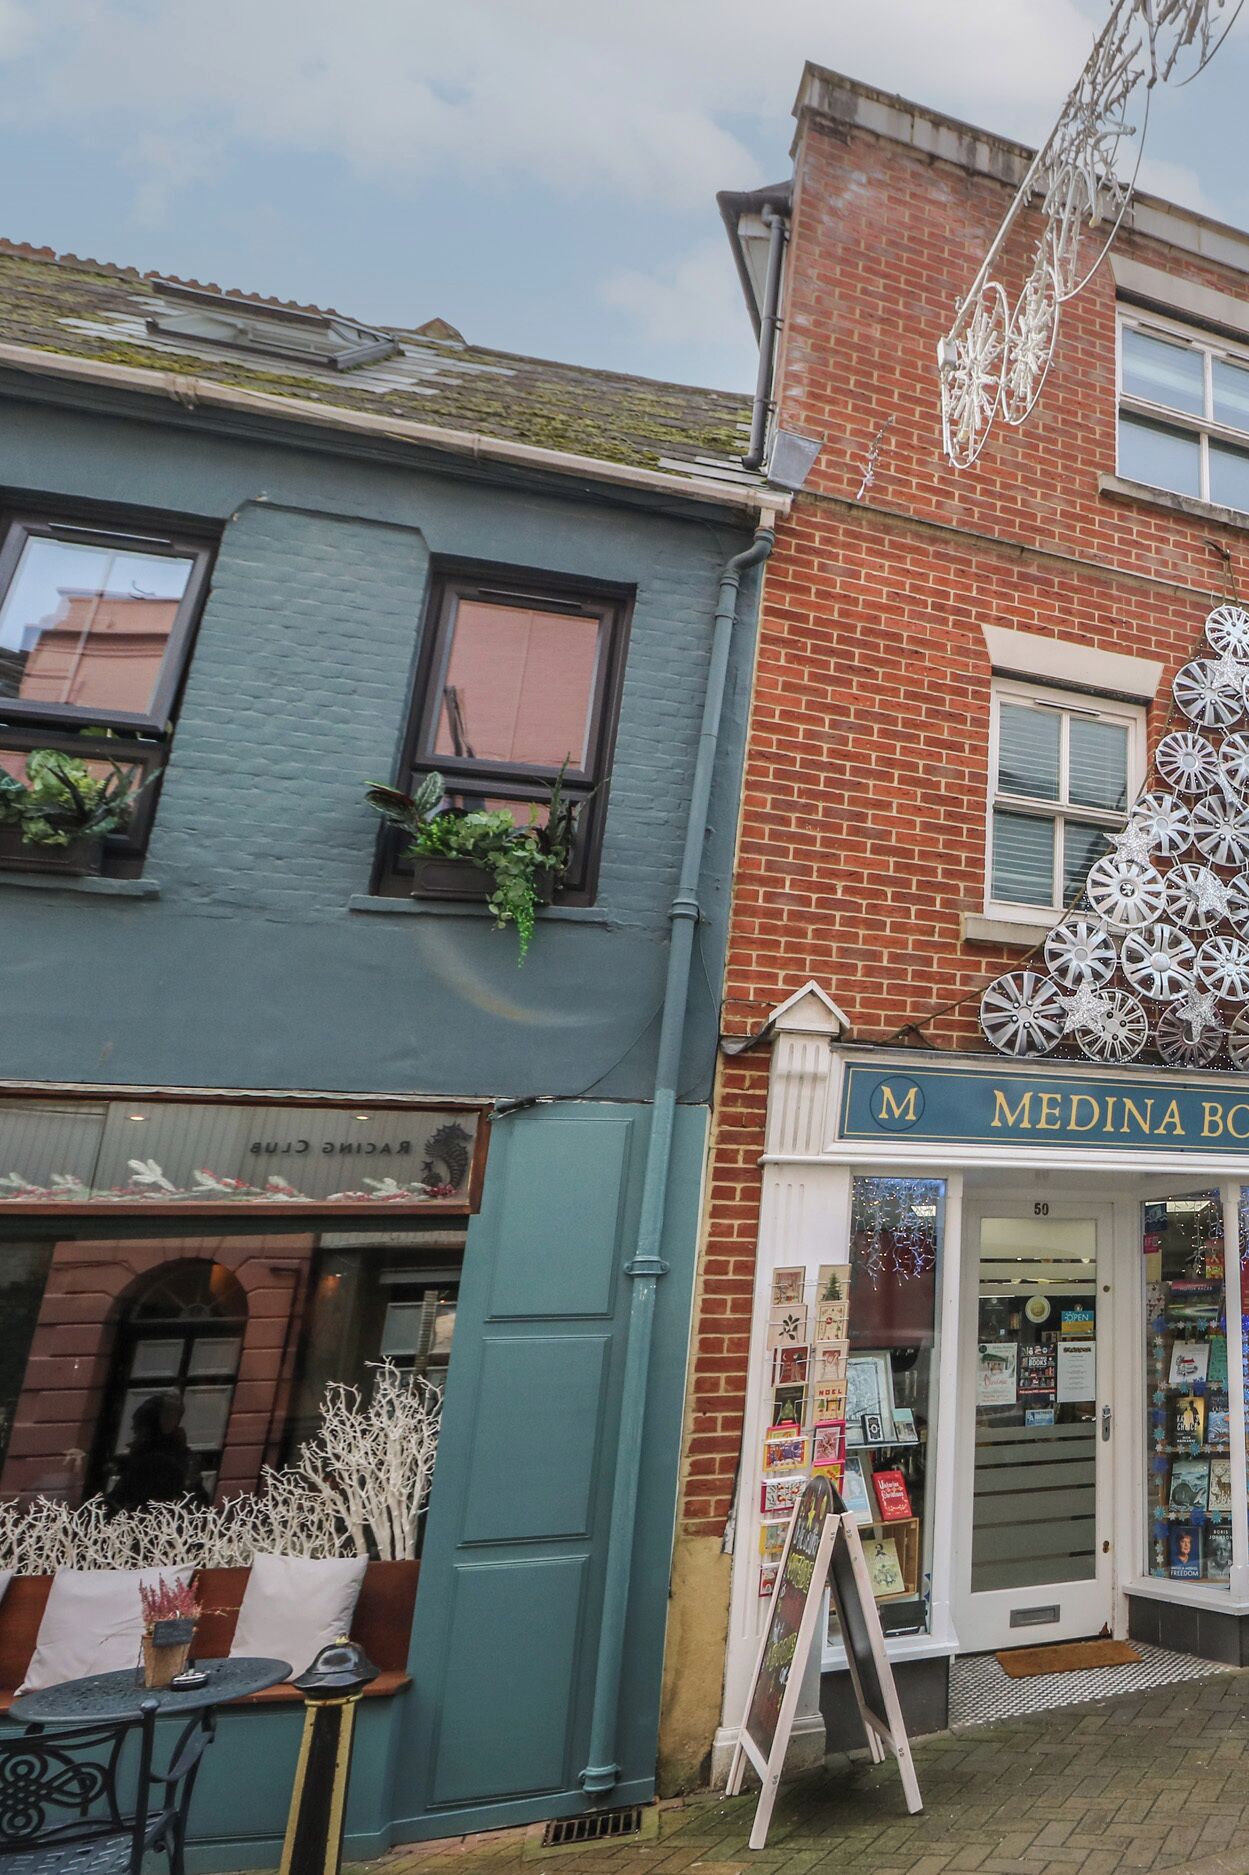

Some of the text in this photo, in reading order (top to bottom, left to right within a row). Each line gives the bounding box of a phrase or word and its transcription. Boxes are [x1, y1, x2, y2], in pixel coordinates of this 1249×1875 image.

[878, 1085, 918, 1121] M
[990, 1089, 1186, 1135] MEDINA
[1033, 1202, 1049, 1216] 50
[1066, 1313, 1089, 1322] OPEN
[818, 1387, 843, 1397] NOEL
